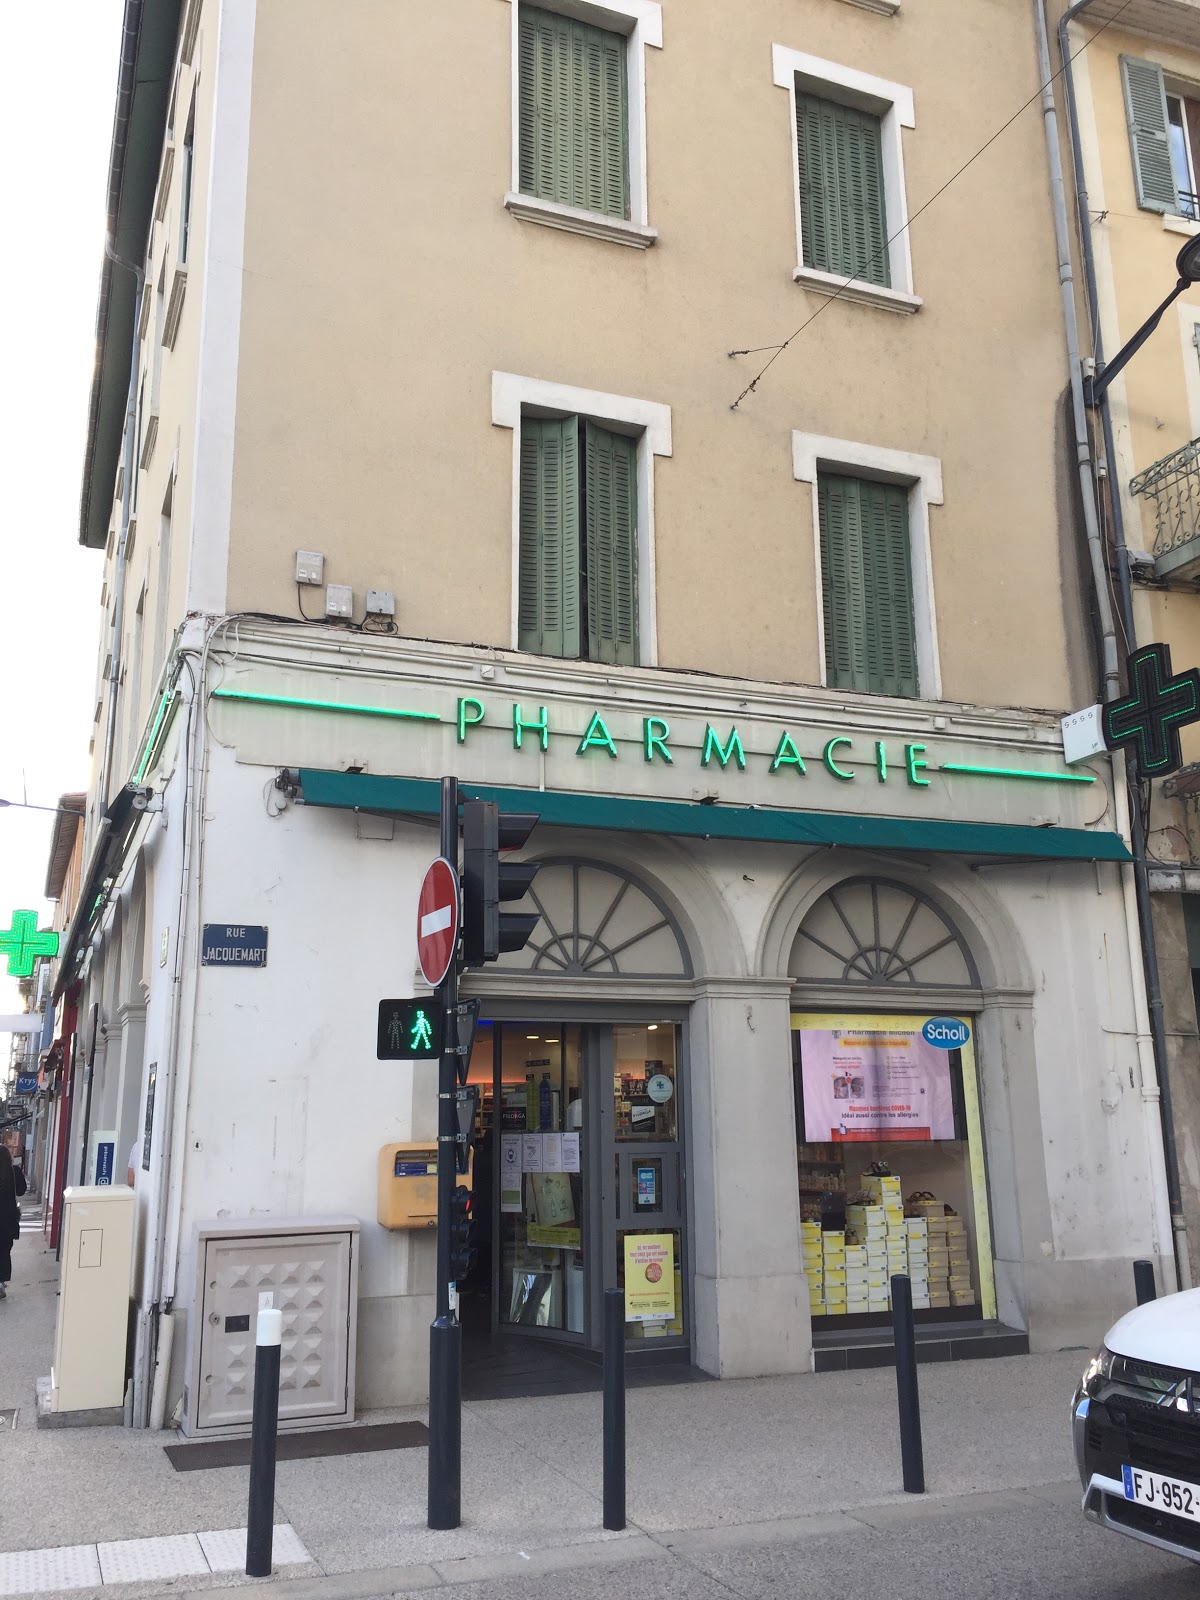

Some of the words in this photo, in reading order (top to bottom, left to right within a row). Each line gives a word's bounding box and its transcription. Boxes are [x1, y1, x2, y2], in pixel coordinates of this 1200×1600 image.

[458, 697, 931, 788] PHARMACIE
[226, 927, 246, 938] RUE
[202, 946, 267, 962] JACQUEMART
[926, 1025, 966, 1042] Scholl
[18, 1077, 36, 1086] Krys
[897, 1111, 919, 1119] allergies
